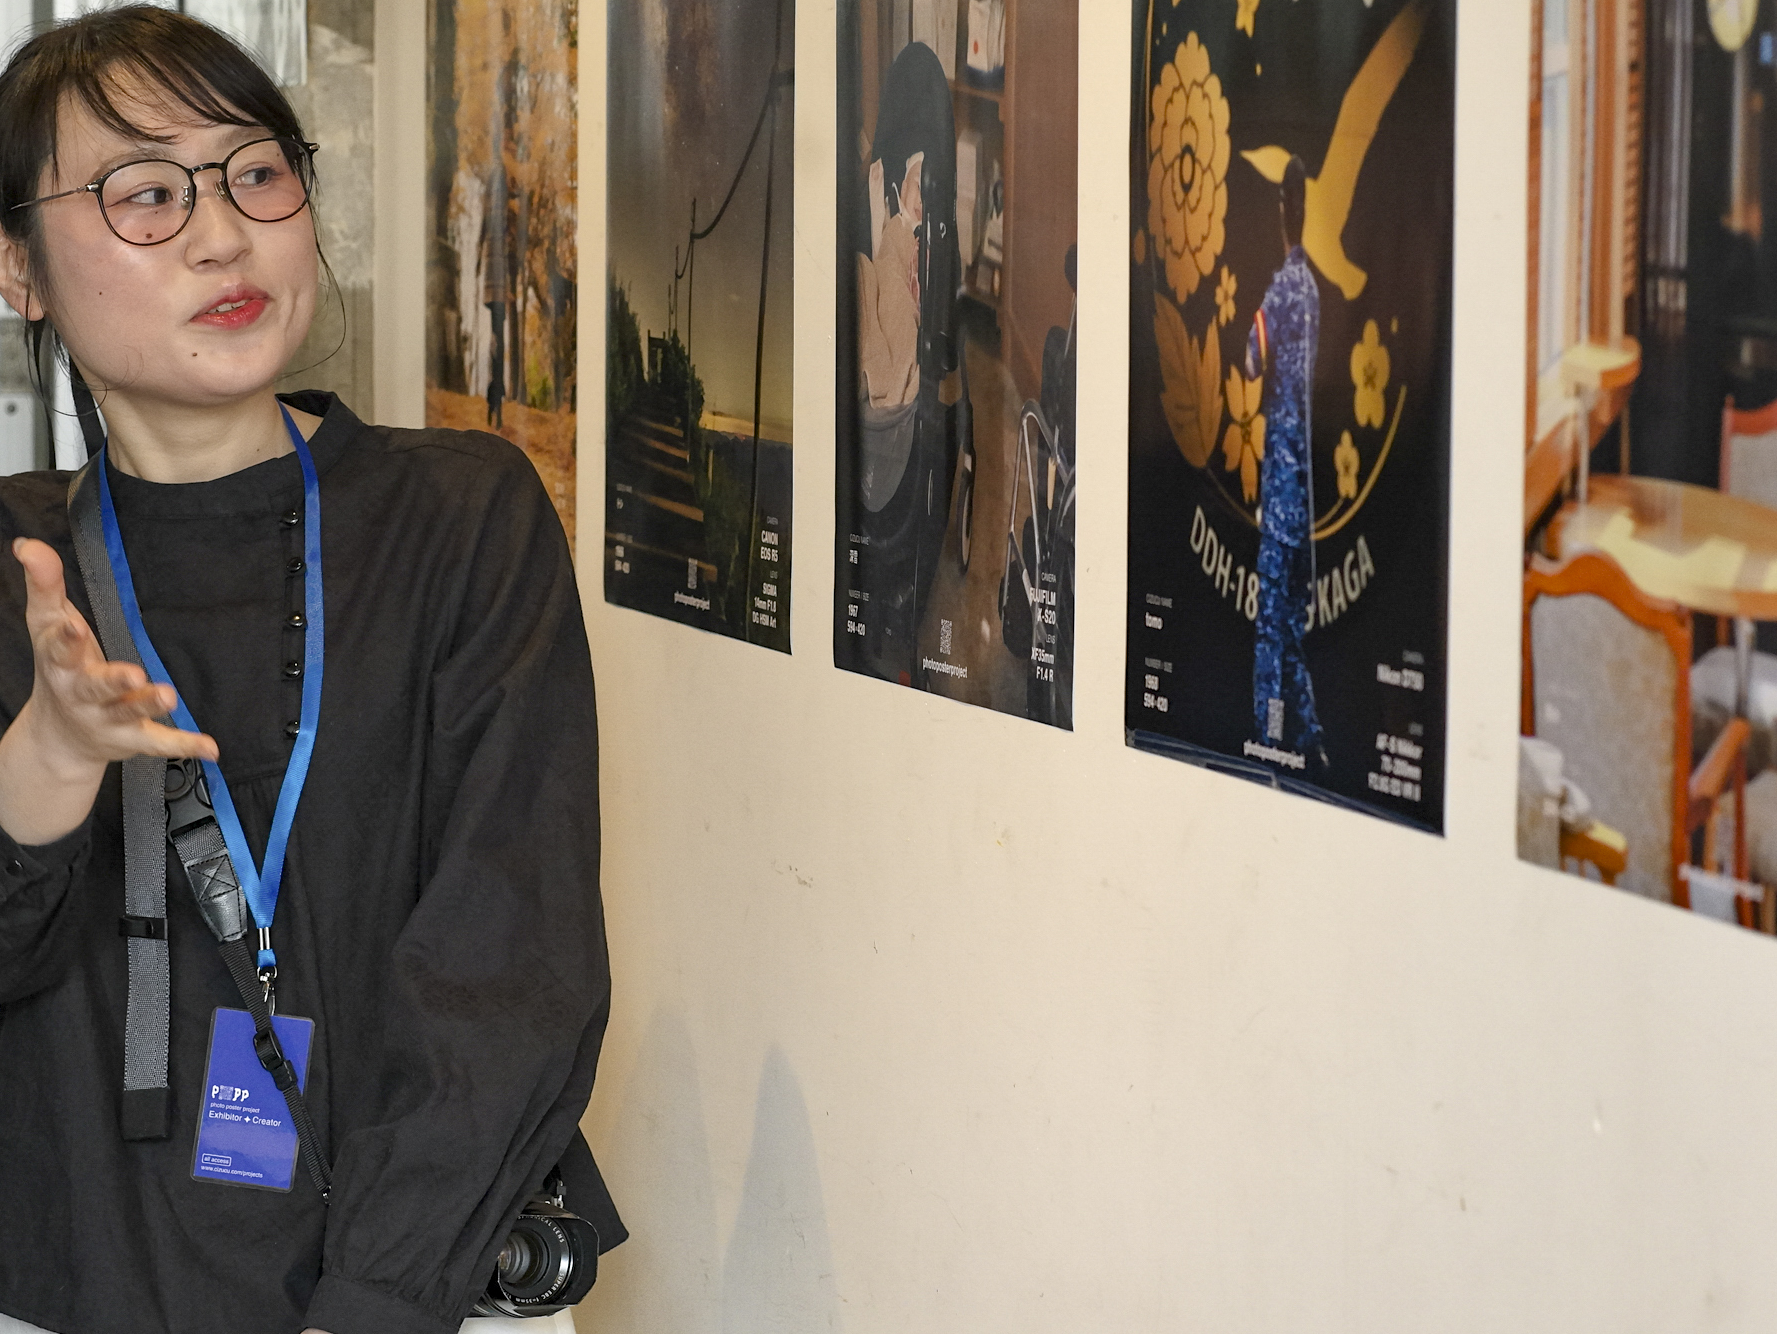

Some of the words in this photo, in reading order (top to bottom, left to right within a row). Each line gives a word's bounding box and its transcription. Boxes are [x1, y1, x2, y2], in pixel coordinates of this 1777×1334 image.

[761, 530, 779, 546] CANON
[760, 547, 771, 561] EOS
[771, 549, 779, 563] R5
[1316, 534, 1375, 628] KAGA
[1029, 587, 1056, 606] FUJIFILM
[1037, 607, 1056, 625] X-S20
[1030, 647, 1055, 665] XF35mm
[923, 655, 968, 679] photoposterproject
[1036, 666, 1048, 682] F1.4
[1048, 669, 1054, 683] R
[209, 1110, 242, 1122] Exhibitor
[252, 1116, 281, 1127] Creator
[553, 1227, 565, 1243] LENS
[551, 1273, 565, 1291] SUPER
[541, 1291, 553, 1299] EBC
